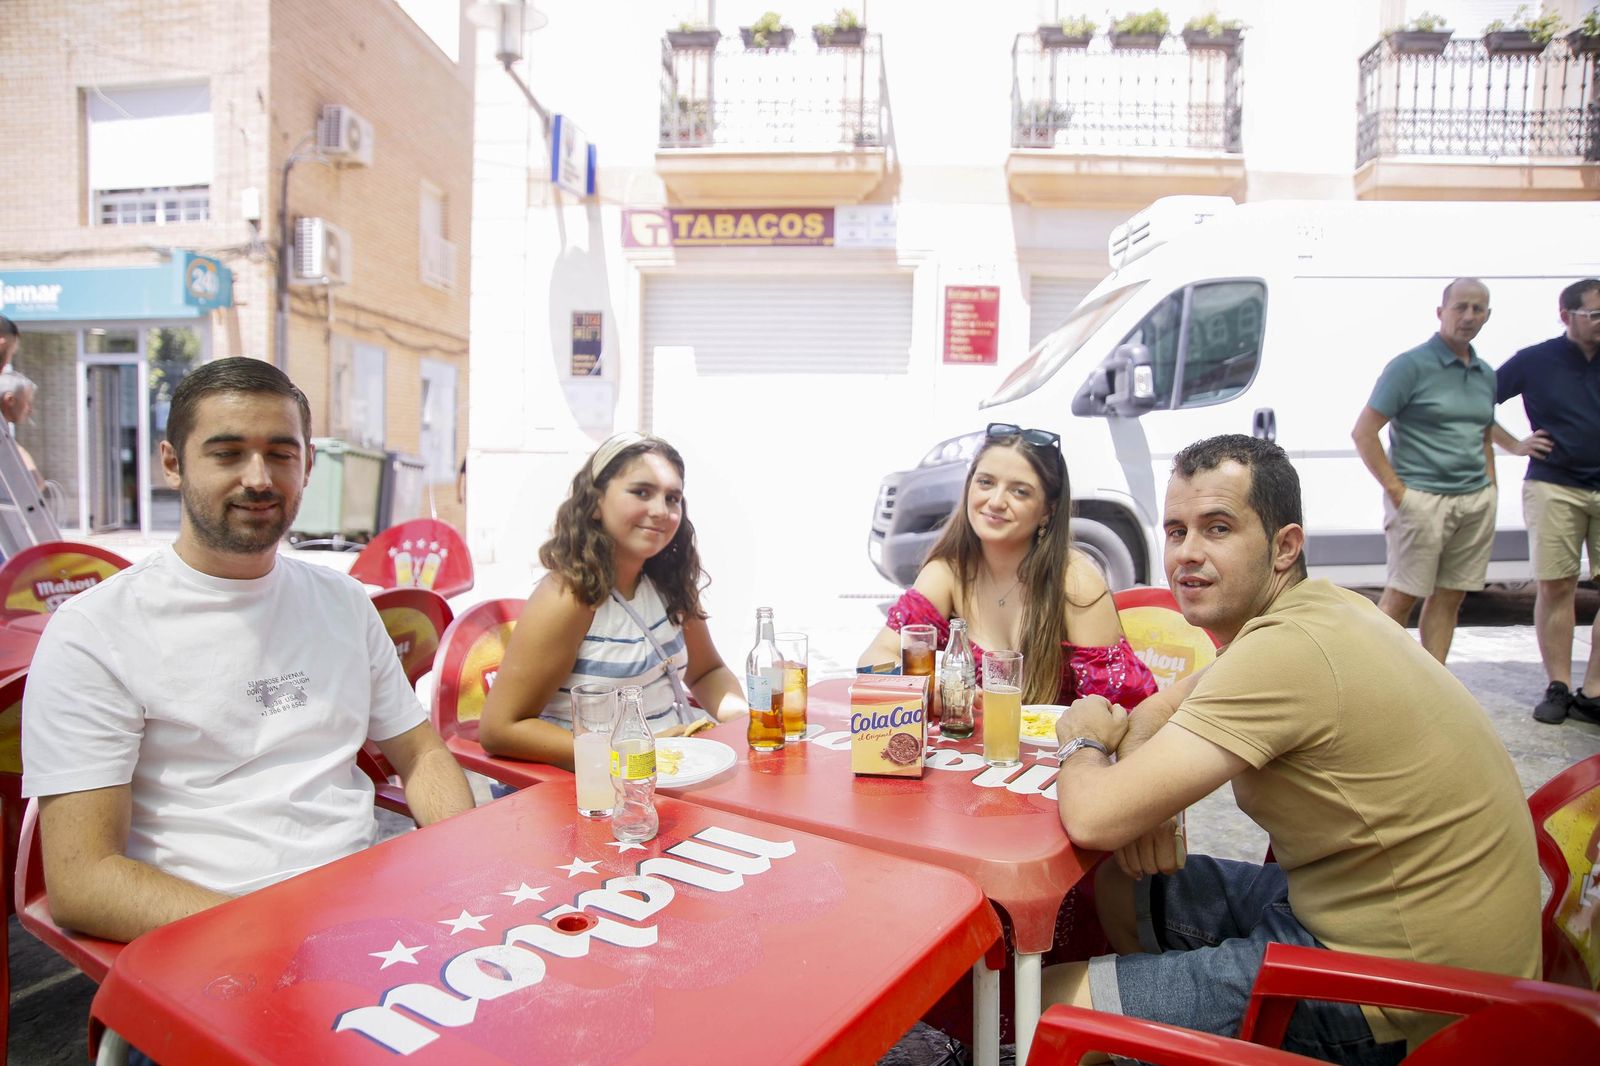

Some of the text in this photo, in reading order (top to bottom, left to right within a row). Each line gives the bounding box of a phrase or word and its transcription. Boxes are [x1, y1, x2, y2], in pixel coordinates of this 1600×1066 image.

[672, 212, 825, 238] TABACOS
[280, 672, 305, 682] AVENUE
[850, 706, 924, 734] ColaCao
